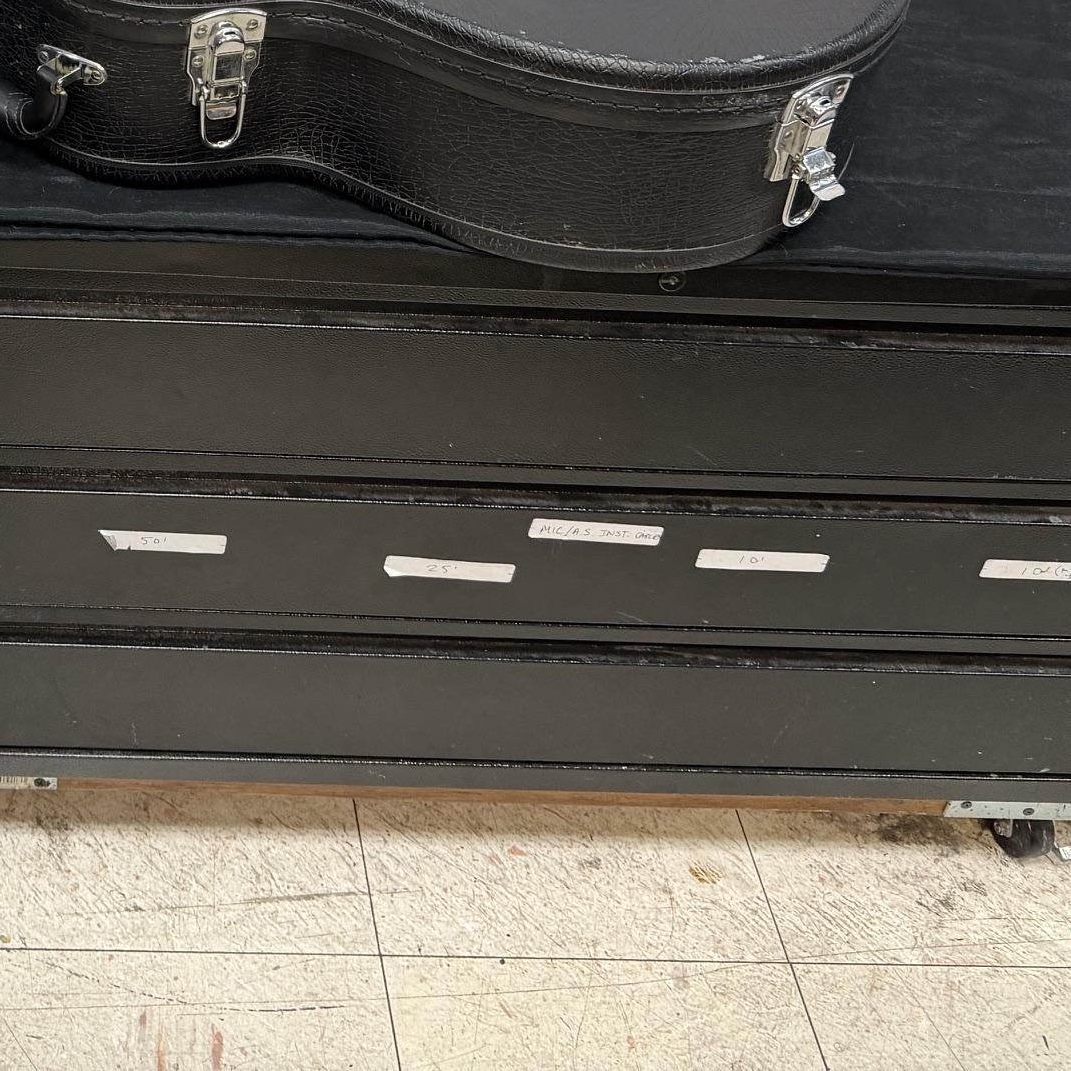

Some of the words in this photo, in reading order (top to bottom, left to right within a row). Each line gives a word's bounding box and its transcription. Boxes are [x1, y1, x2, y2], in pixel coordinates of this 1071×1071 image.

[140, 536, 167, 546] 50'
[739, 555, 765, 564] 10'
[426, 564, 458, 574] 25'
